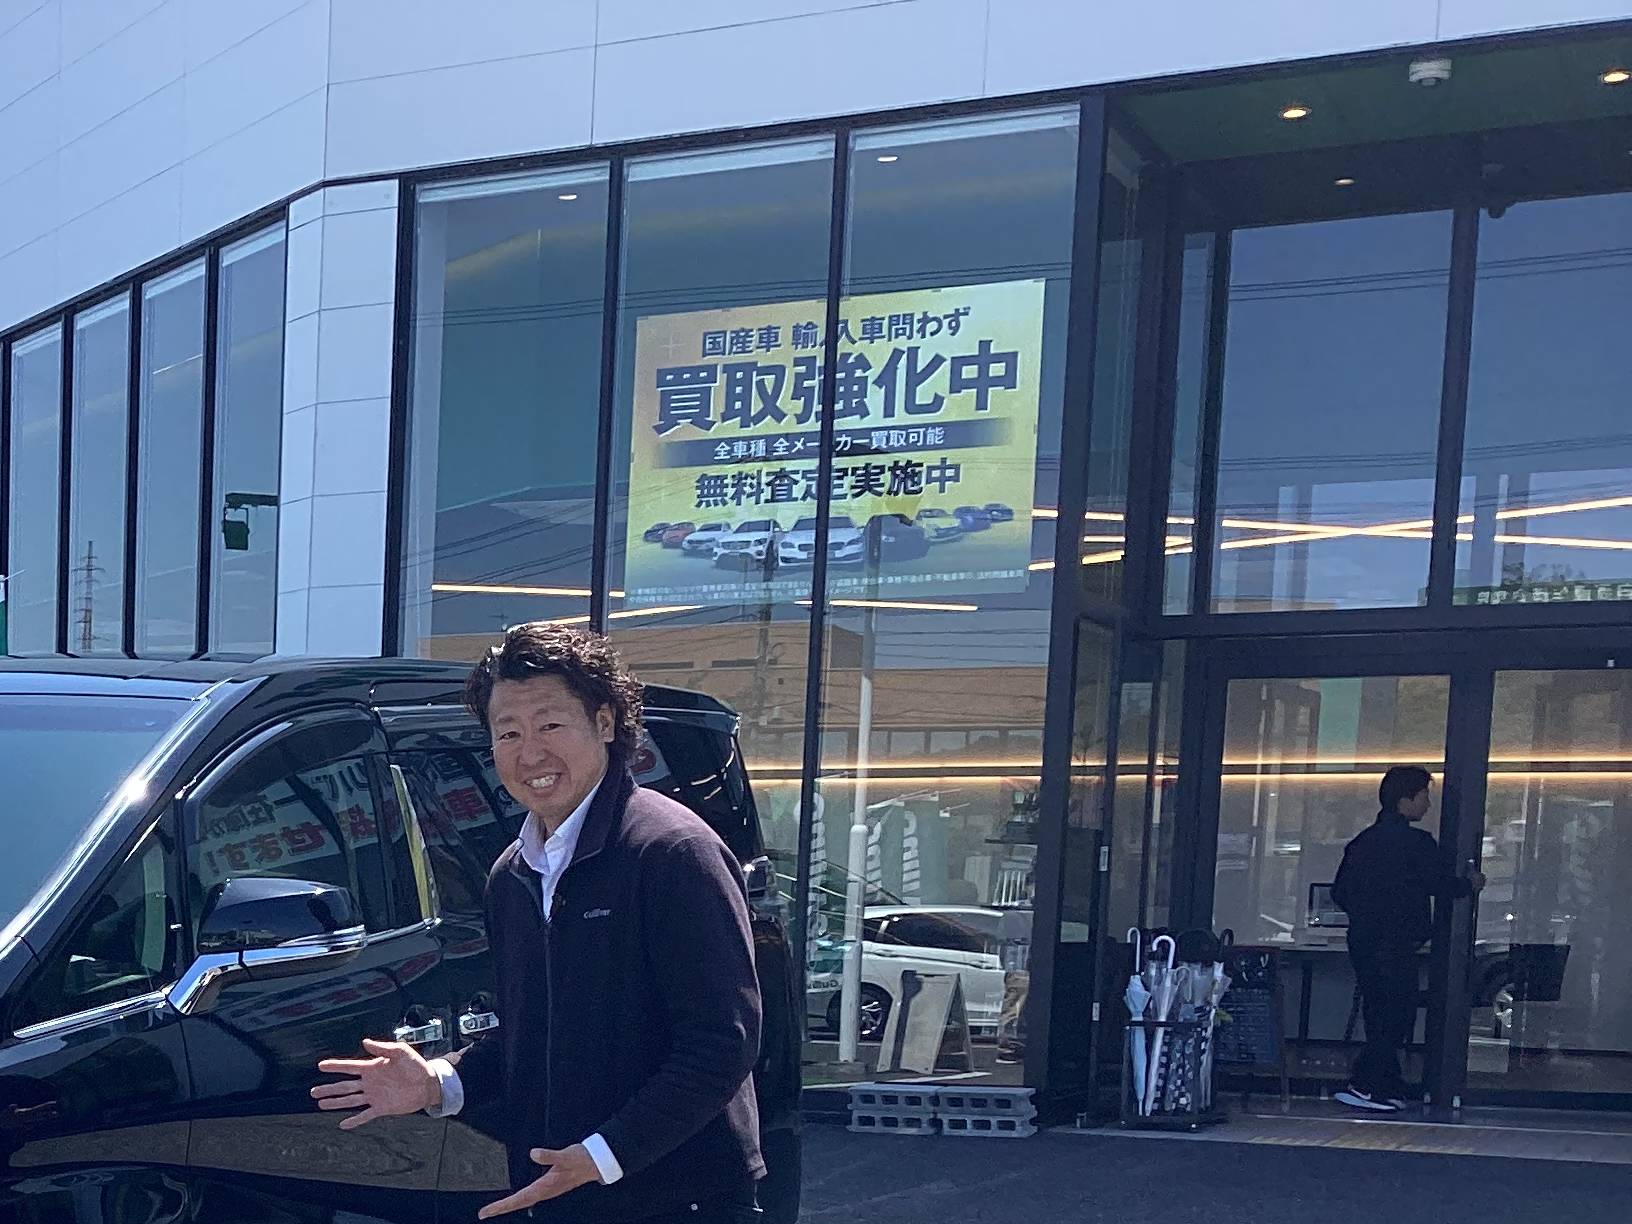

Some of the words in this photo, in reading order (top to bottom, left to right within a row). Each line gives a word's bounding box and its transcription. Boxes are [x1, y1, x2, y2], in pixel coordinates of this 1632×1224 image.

[702, 324, 782, 358] 国産車
[652, 339, 1019, 437] 買取強化中
[713, 438, 767, 461] 全車種
[772, 426, 946, 457] 全メーカー買取可能
[695, 457, 962, 508] 無料査定実施中
